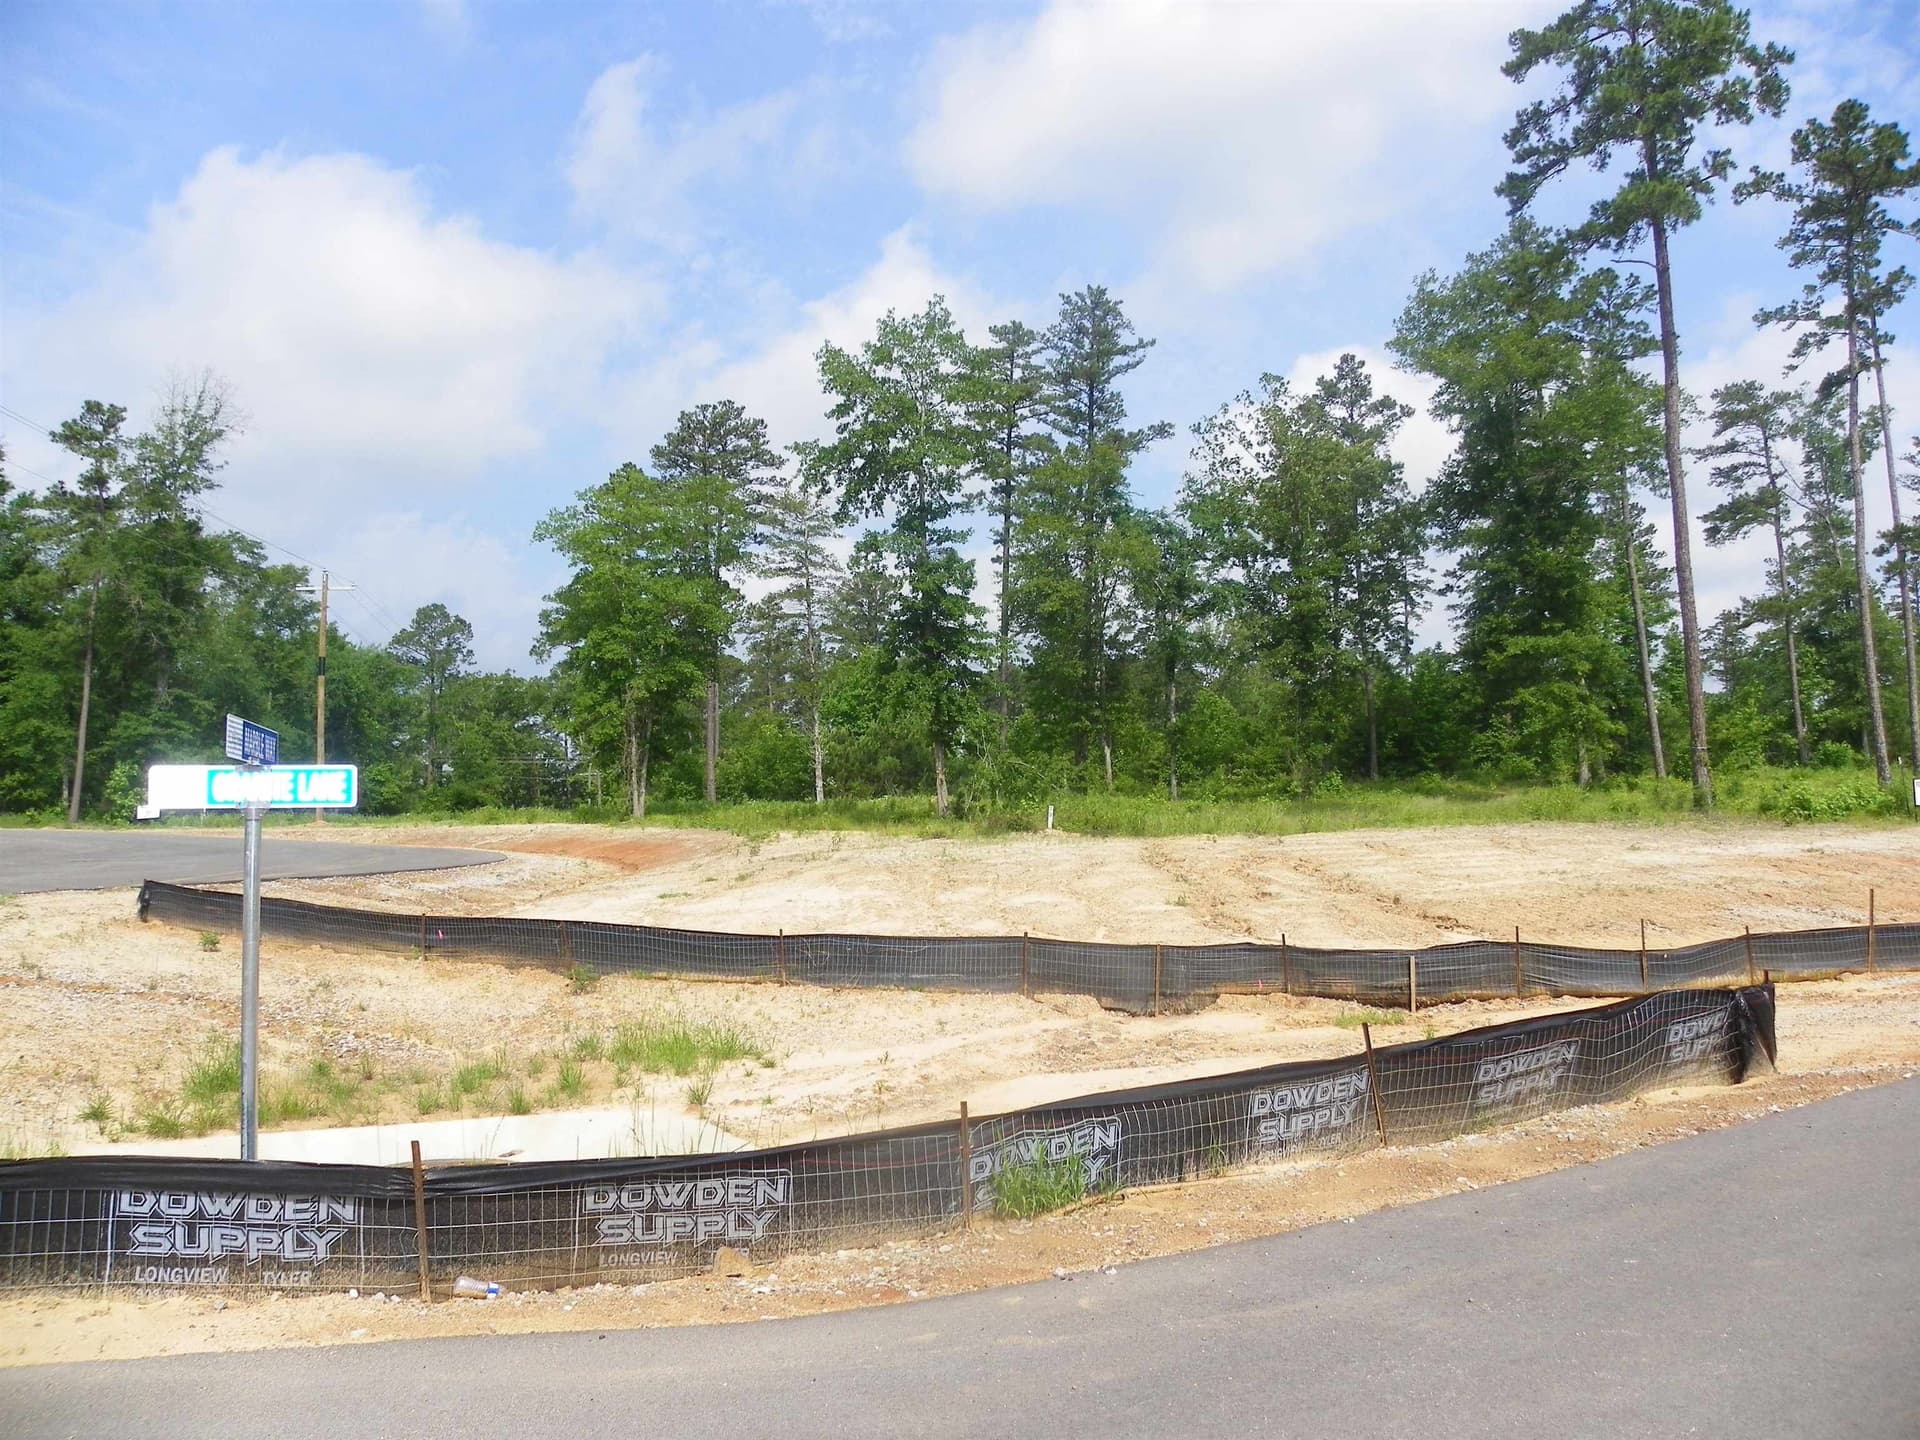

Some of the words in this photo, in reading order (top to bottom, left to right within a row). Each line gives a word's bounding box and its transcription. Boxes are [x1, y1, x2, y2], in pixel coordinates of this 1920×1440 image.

[1478, 1043, 1578, 1083] DOWDEN
[1252, 1069, 1369, 1116] DOWDEN
[1256, 1101, 1358, 1143] SUPPLY
[969, 1123, 1118, 1183] DOWDEN
[116, 1191, 358, 1226] DOWDEN
[584, 1176, 789, 1213] DOWDEN
[127, 1221, 348, 1266] SUPPLY
[592, 1209, 779, 1247] SUPPLY
[134, 1267, 228, 1284] LONGVIEW
[600, 1250, 678, 1267] LONGVIEW
